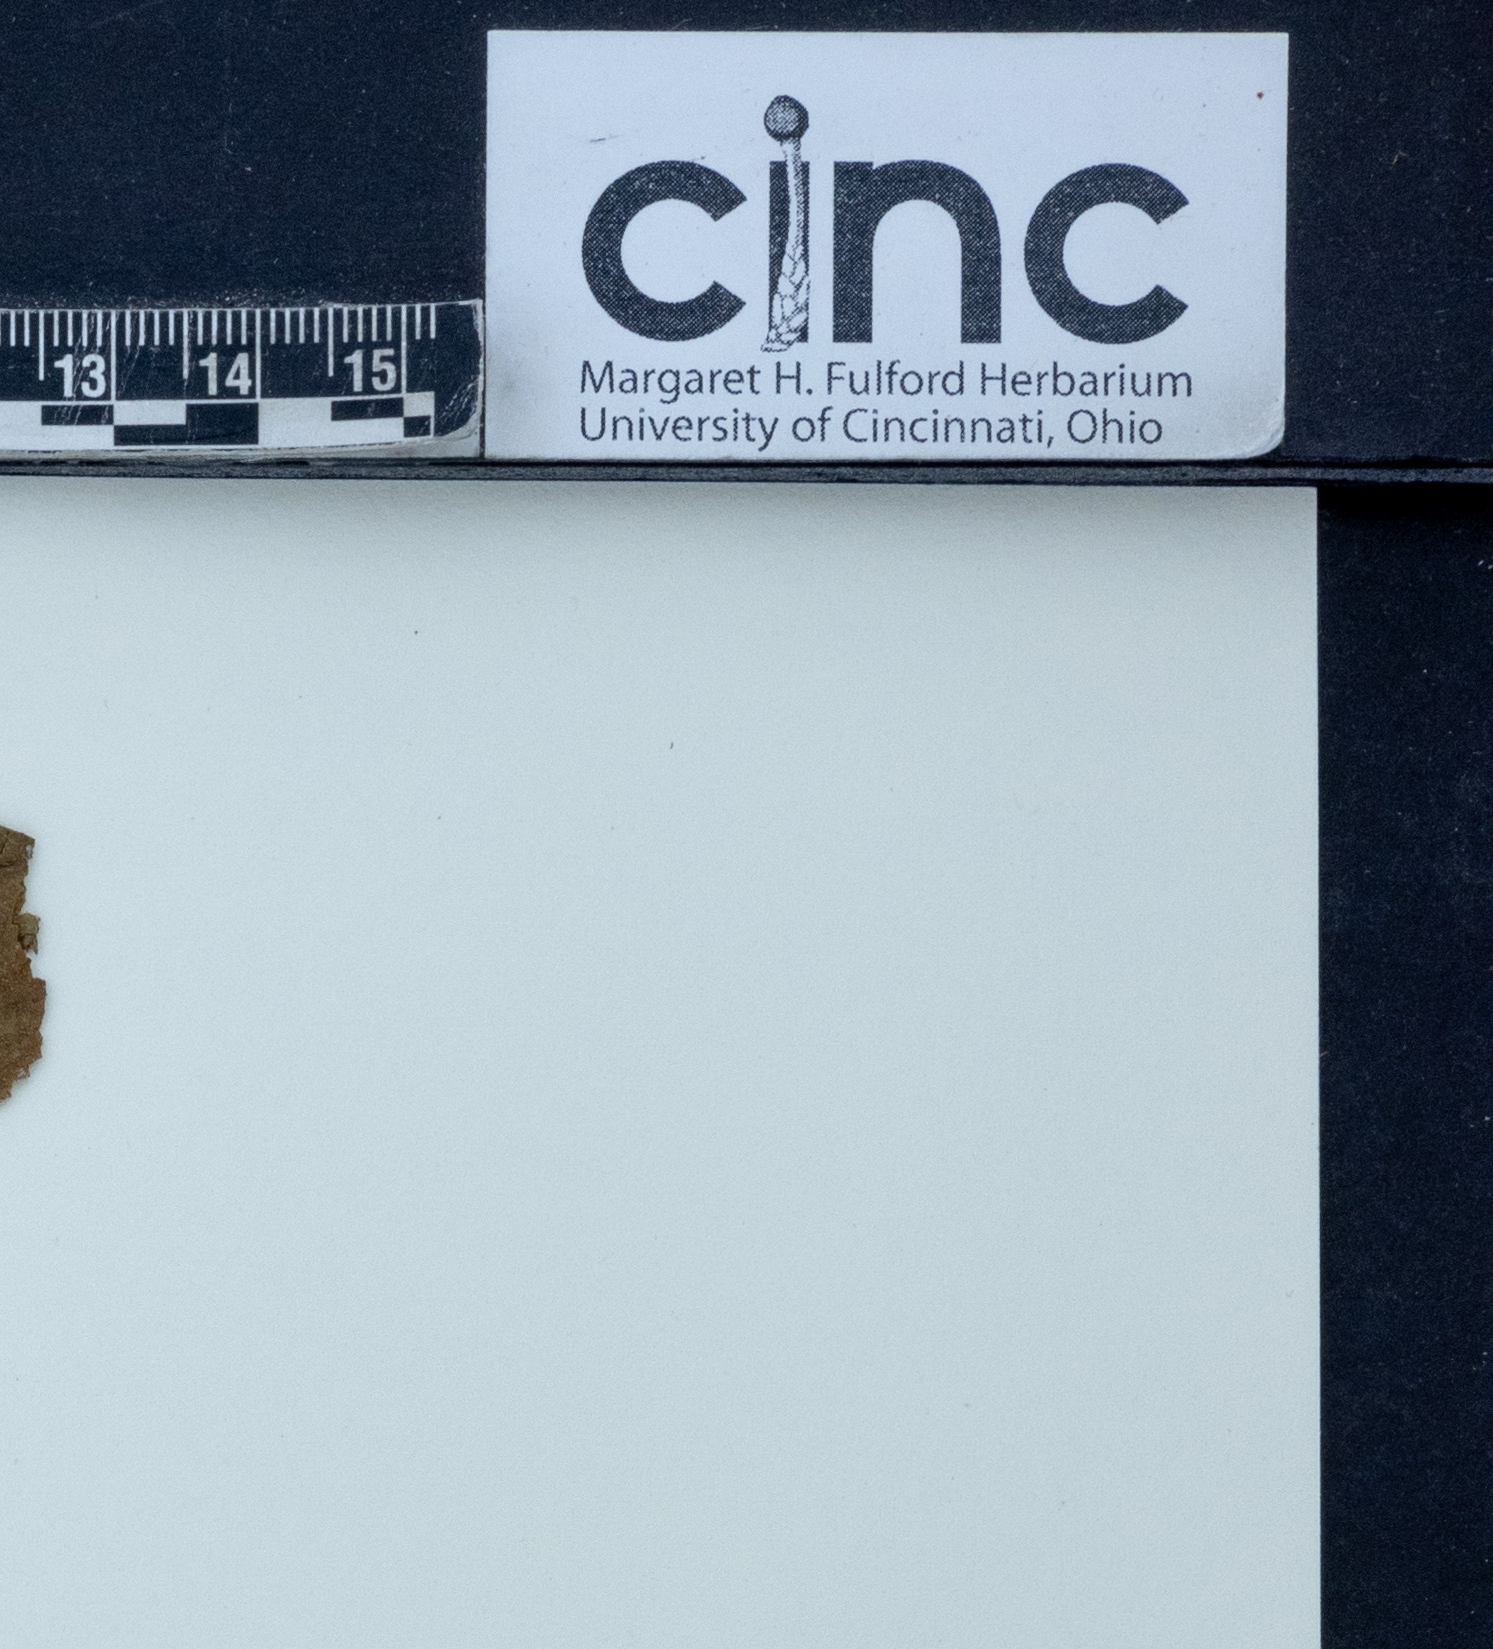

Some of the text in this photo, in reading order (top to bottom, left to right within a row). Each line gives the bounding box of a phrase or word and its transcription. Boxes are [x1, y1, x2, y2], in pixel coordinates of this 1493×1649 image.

[581, 92, 1191, 352] cinc
[55, 354, 106, 397] 13
[199, 353, 252, 395] 14
[344, 349, 396, 392] 15
[581, 360, 1192, 404] Margaret H. Fulford Herbarium
[581, 406, 1162, 452] University of Cincinnati, Ohio
